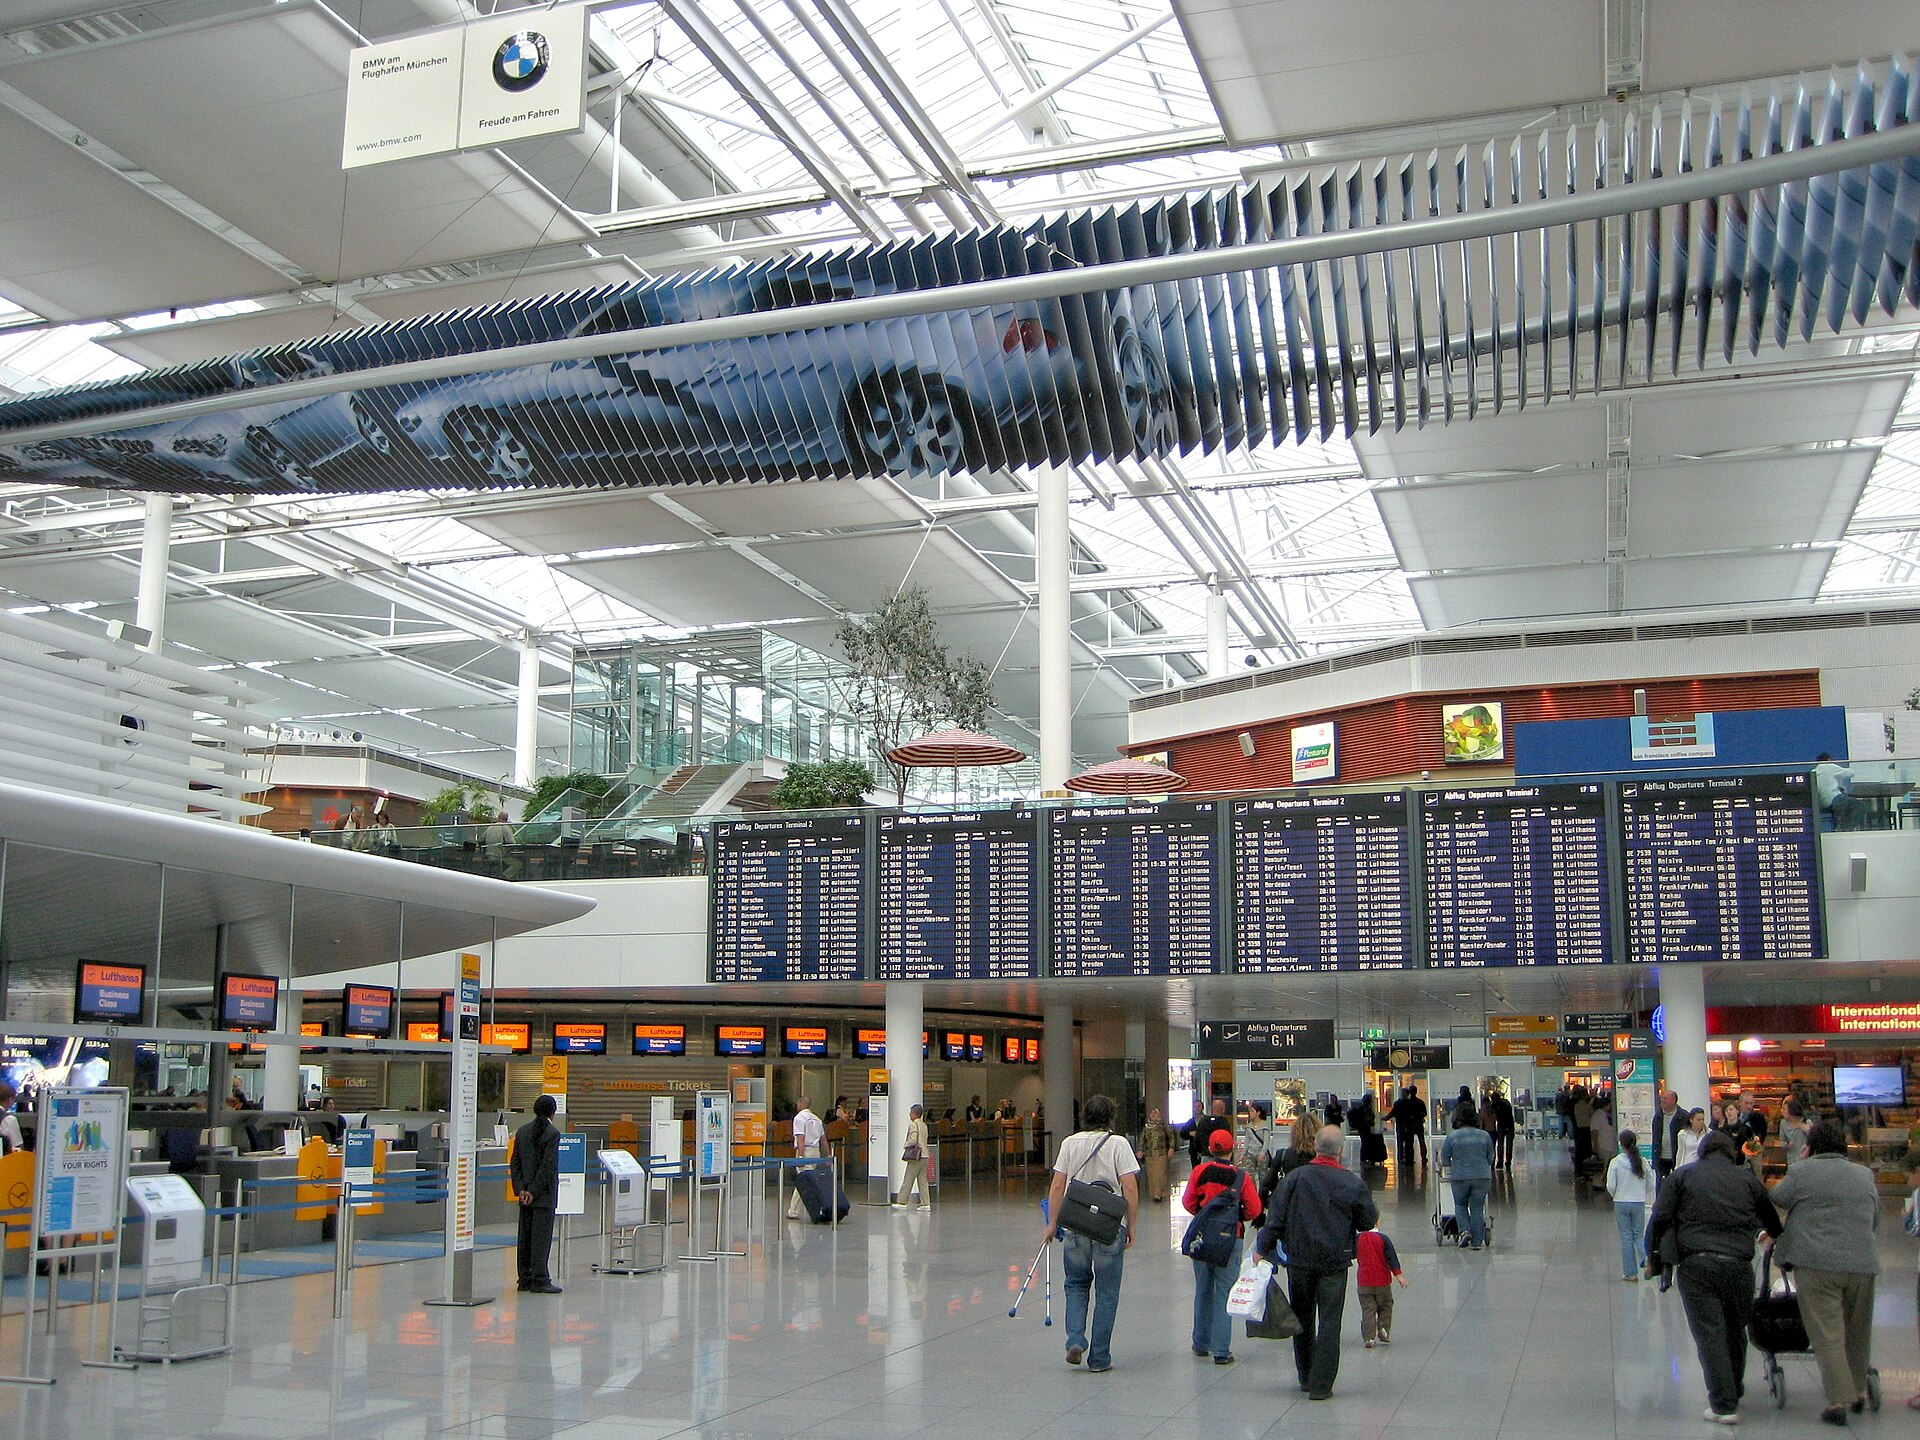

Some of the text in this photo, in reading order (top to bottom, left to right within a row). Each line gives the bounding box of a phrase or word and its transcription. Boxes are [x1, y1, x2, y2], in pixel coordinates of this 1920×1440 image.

[362, 56, 401, 70] BMW am
[362, 56, 448, 80] Flughafen München
[479, 108, 560, 128] Freude am Fahren
[356, 134, 422, 151] www.bmw.com
[1644, 779, 1743, 791] Abflug Departures Terminal 2
[1444, 788, 1540, 800] Abflug Departures Terminal 2
[1254, 798, 1345, 810] Abflug Departures Terminal 2
[1071, 806, 1159, 817] Abflug Departures Terminal 2
[898, 817, 917, 825] Abflug
[919, 815, 949, 824] Departures
[735, 823, 752, 832] Abflug
[754, 822, 783, 830] Departures
[101, 971, 139, 983] Lufthansa
[241, 983, 273, 993] Lufthansa
[100, 990, 130, 1000] Business
[362, 993, 389, 1003] Lufthansa
[99, 999, 118, 1008] Class
[240, 1000, 265, 1008] Business
[1831, 1005, 1920, 1017] International
[105, 1027, 120, 1037] 457
[1247, 1024, 1308, 1033] Abflug Departures
[4, 1035, 48, 1046] kennen nur
[1272, 1034, 1283, 1048] G,
[1286, 1034, 1295, 1046] H
[1617, 1037, 1629, 1049] M
[11, 1049, 32, 1058] Kurs.
[603, 1079, 711, 1091] Lufthansa Tickets
[62, 1160, 108, 1170] YOUR RIGHTS
